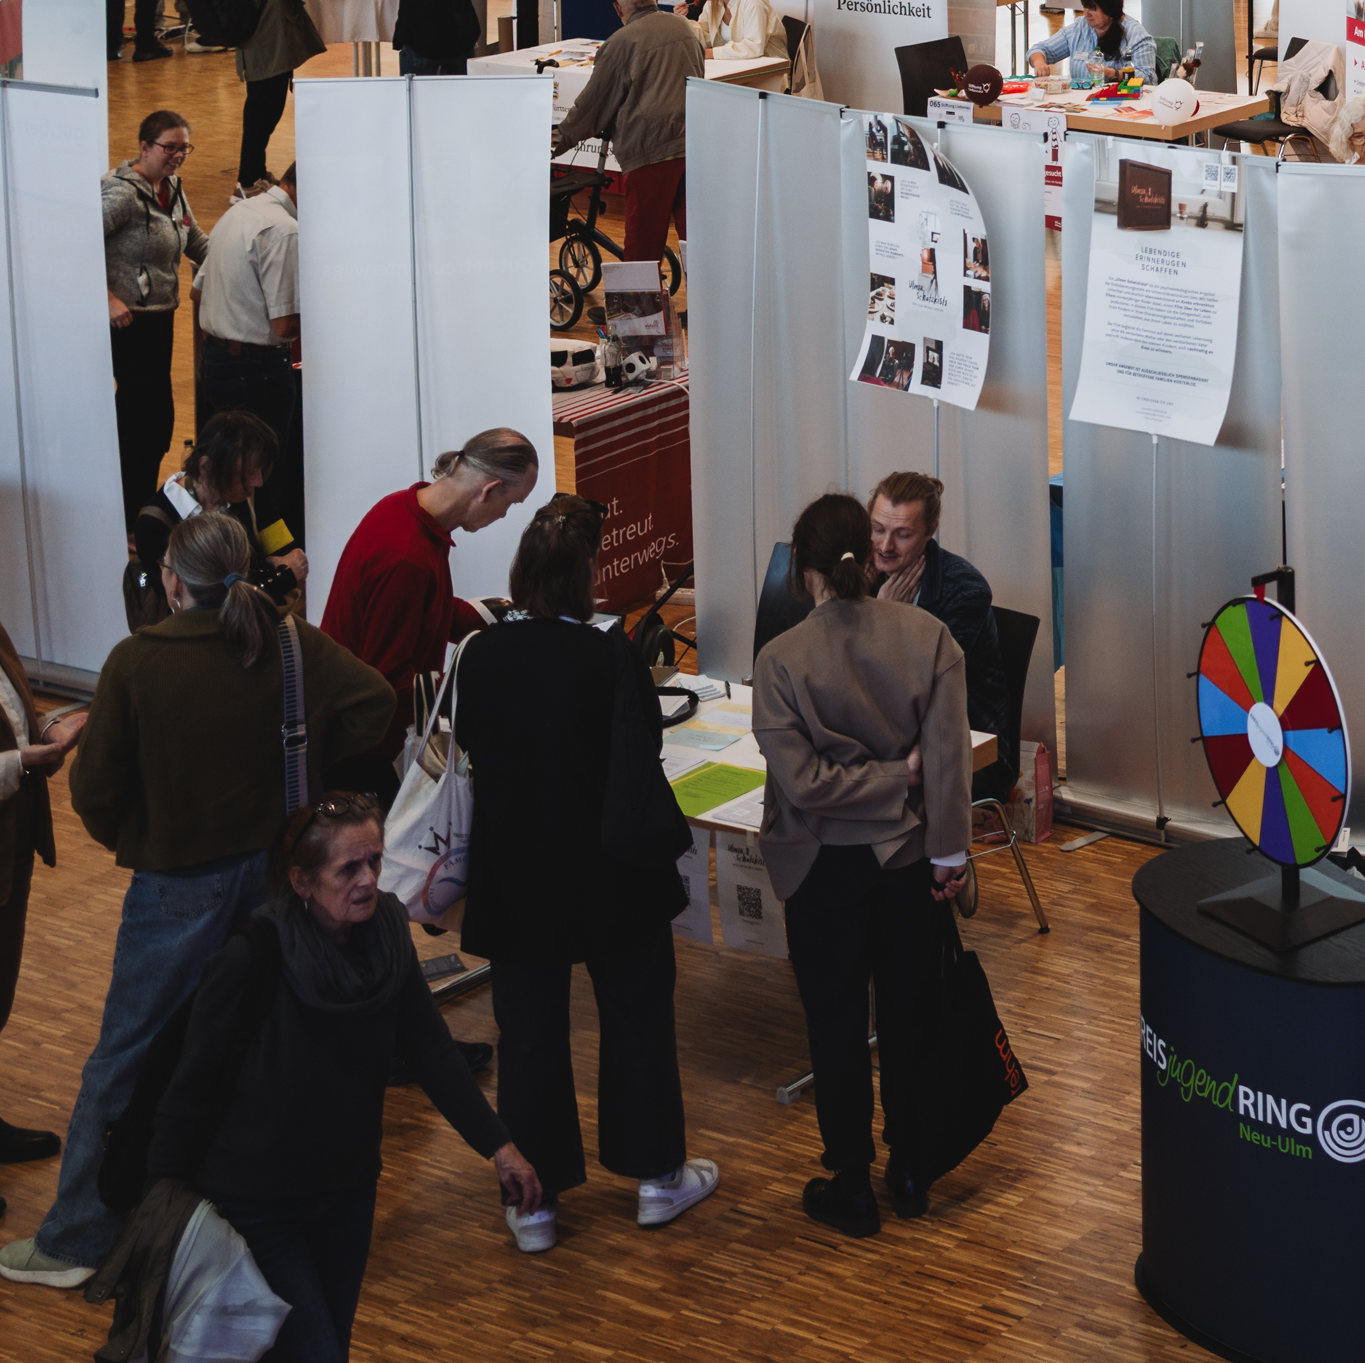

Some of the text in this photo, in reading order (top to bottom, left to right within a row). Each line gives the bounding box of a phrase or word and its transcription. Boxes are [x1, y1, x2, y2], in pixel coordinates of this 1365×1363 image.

[1354, 27, 1362, 36] Am
[929, 99, 941, 108] 065
[1141, 246, 1181, 258] LEBENDIGE
[1135, 254, 1186, 268] ERINNERUGEN
[1141, 263, 1179, 276] SCHAFFEN
[1240, 1122, 1312, 1159] Neu-Ulm
